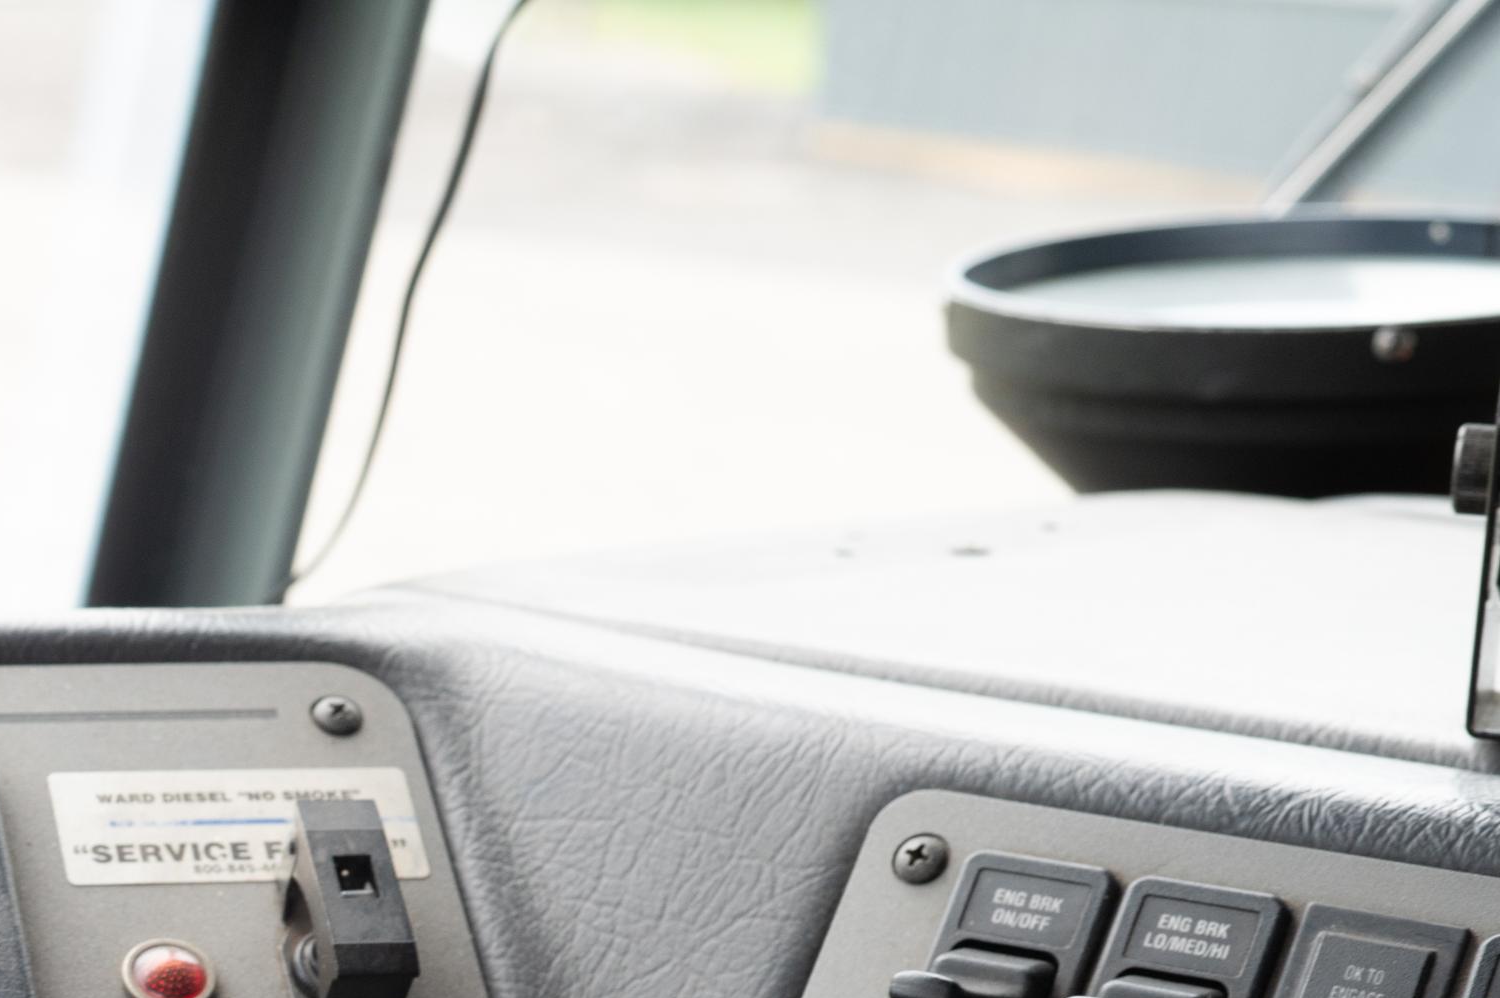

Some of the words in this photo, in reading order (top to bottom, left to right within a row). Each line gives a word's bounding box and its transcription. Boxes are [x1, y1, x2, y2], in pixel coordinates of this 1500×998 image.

[97, 793, 155, 804] WARD
[162, 791, 231, 803] DIESEL
[992, 887, 1026, 907] ENG
[1029, 894, 1063, 914] BRK
[991, 911, 1052, 932] ON/OFF
[1157, 914, 1192, 932] ENG
[1194, 921, 1231, 940] BRK
[1143, 936, 1230, 960] LO/MED/HI
[1343, 963, 1364, 983] OK
[1367, 969, 1385, 985] TO
